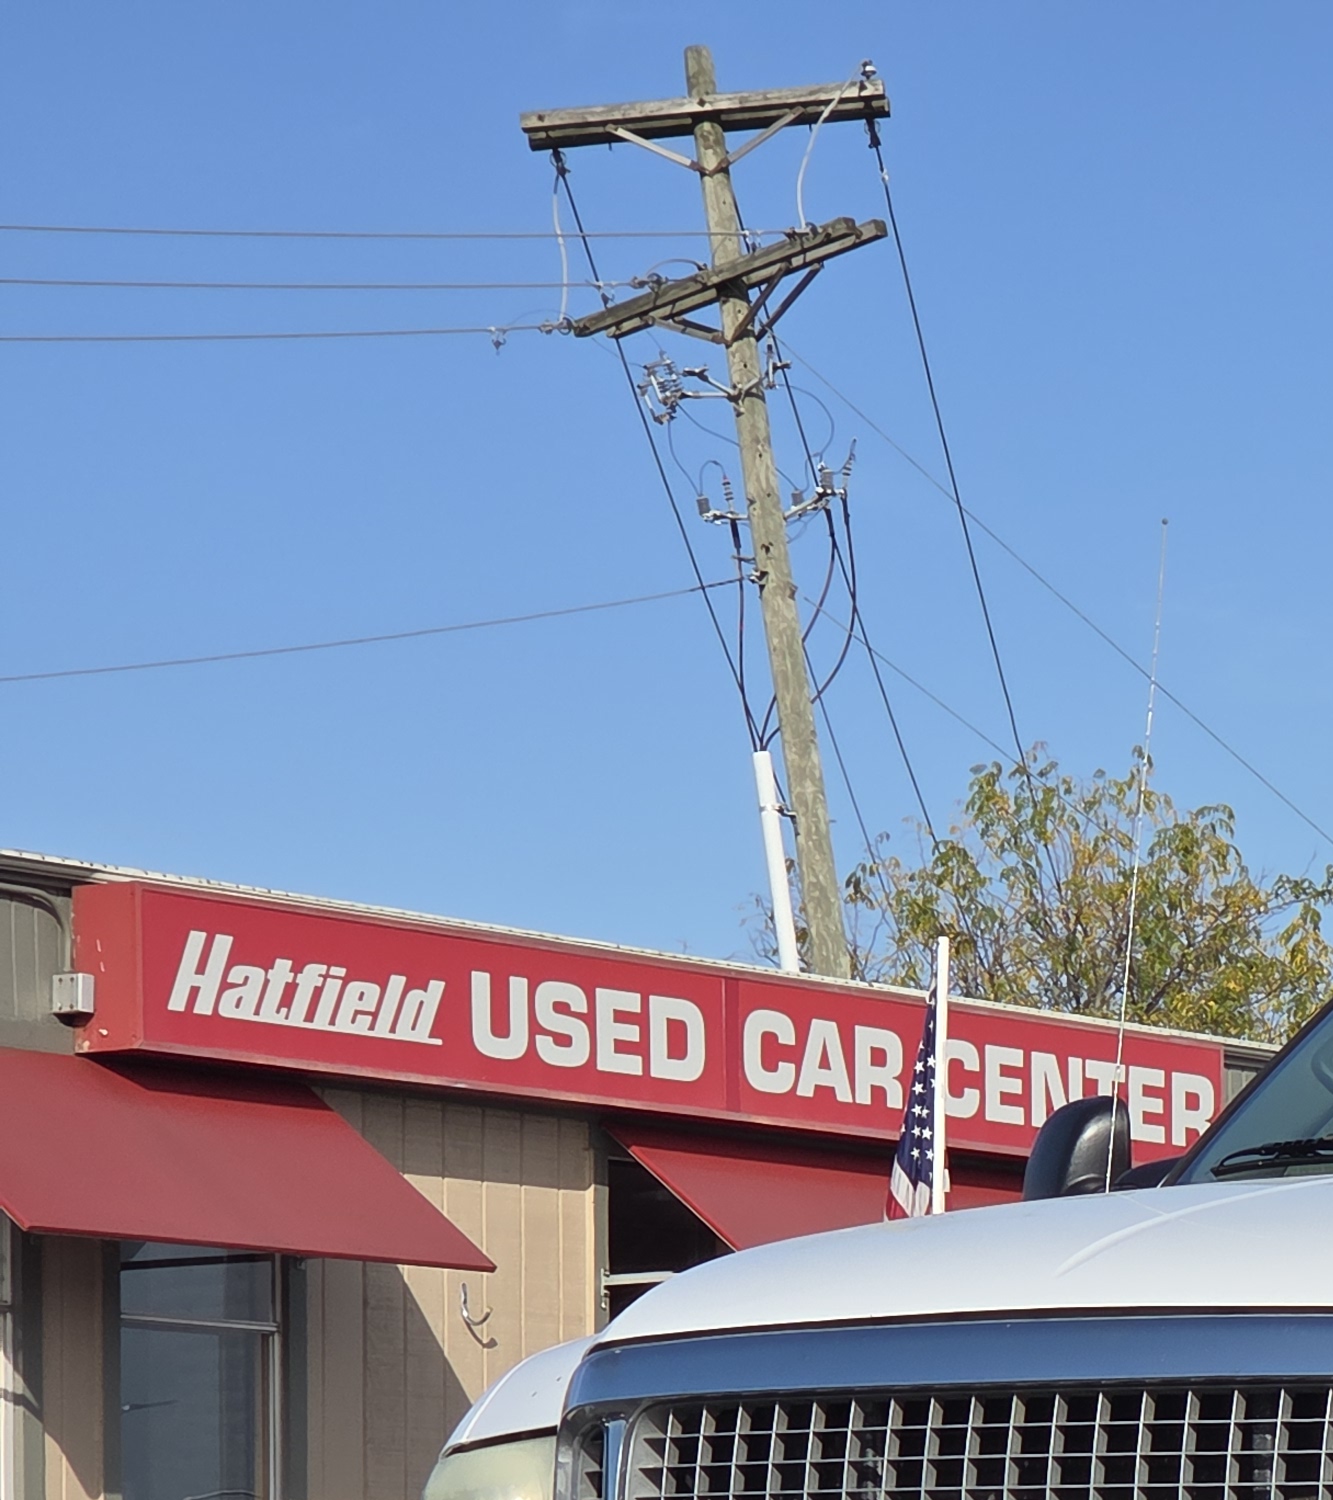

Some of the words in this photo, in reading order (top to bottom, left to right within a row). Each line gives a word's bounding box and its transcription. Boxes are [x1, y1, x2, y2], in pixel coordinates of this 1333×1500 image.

[167, 930, 446, 1046] Hatfield
[470, 971, 704, 1083] USED
[742, 1009, 902, 1109] CAR
[945, 1038, 1214, 1148] CENTER
